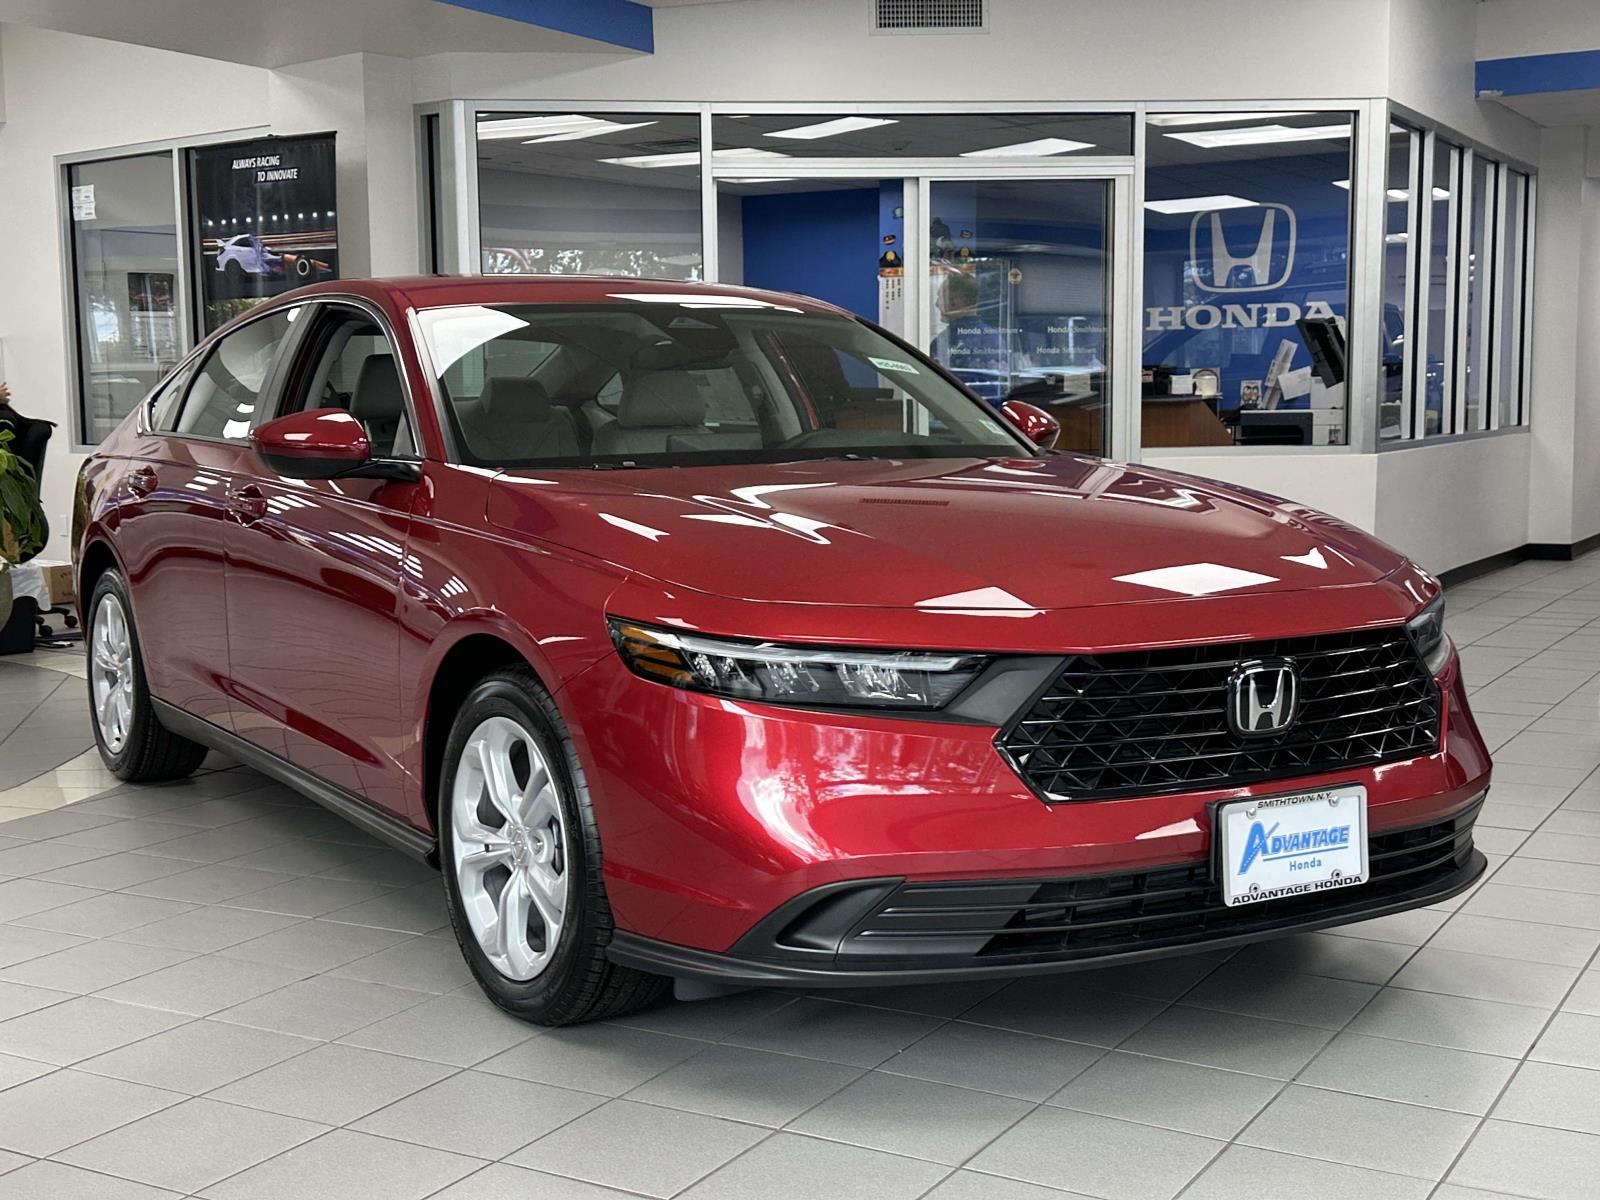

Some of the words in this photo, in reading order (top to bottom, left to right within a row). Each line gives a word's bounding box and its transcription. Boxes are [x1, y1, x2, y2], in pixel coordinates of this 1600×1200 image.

[231, 158, 256, 169] ALWAYS
[256, 155, 280, 167] RACING
[257, 171, 266, 181] TO
[266, 169, 298, 180] INNOVATE
[1145, 301, 1338, 330] HONDA
[1237, 821, 1350, 875] ADVANTAGE
[1289, 858, 1322, 871] Honda
[1232, 884, 1311, 905] ADVANTAGE
[1314, 876, 1362, 890] HONDA
